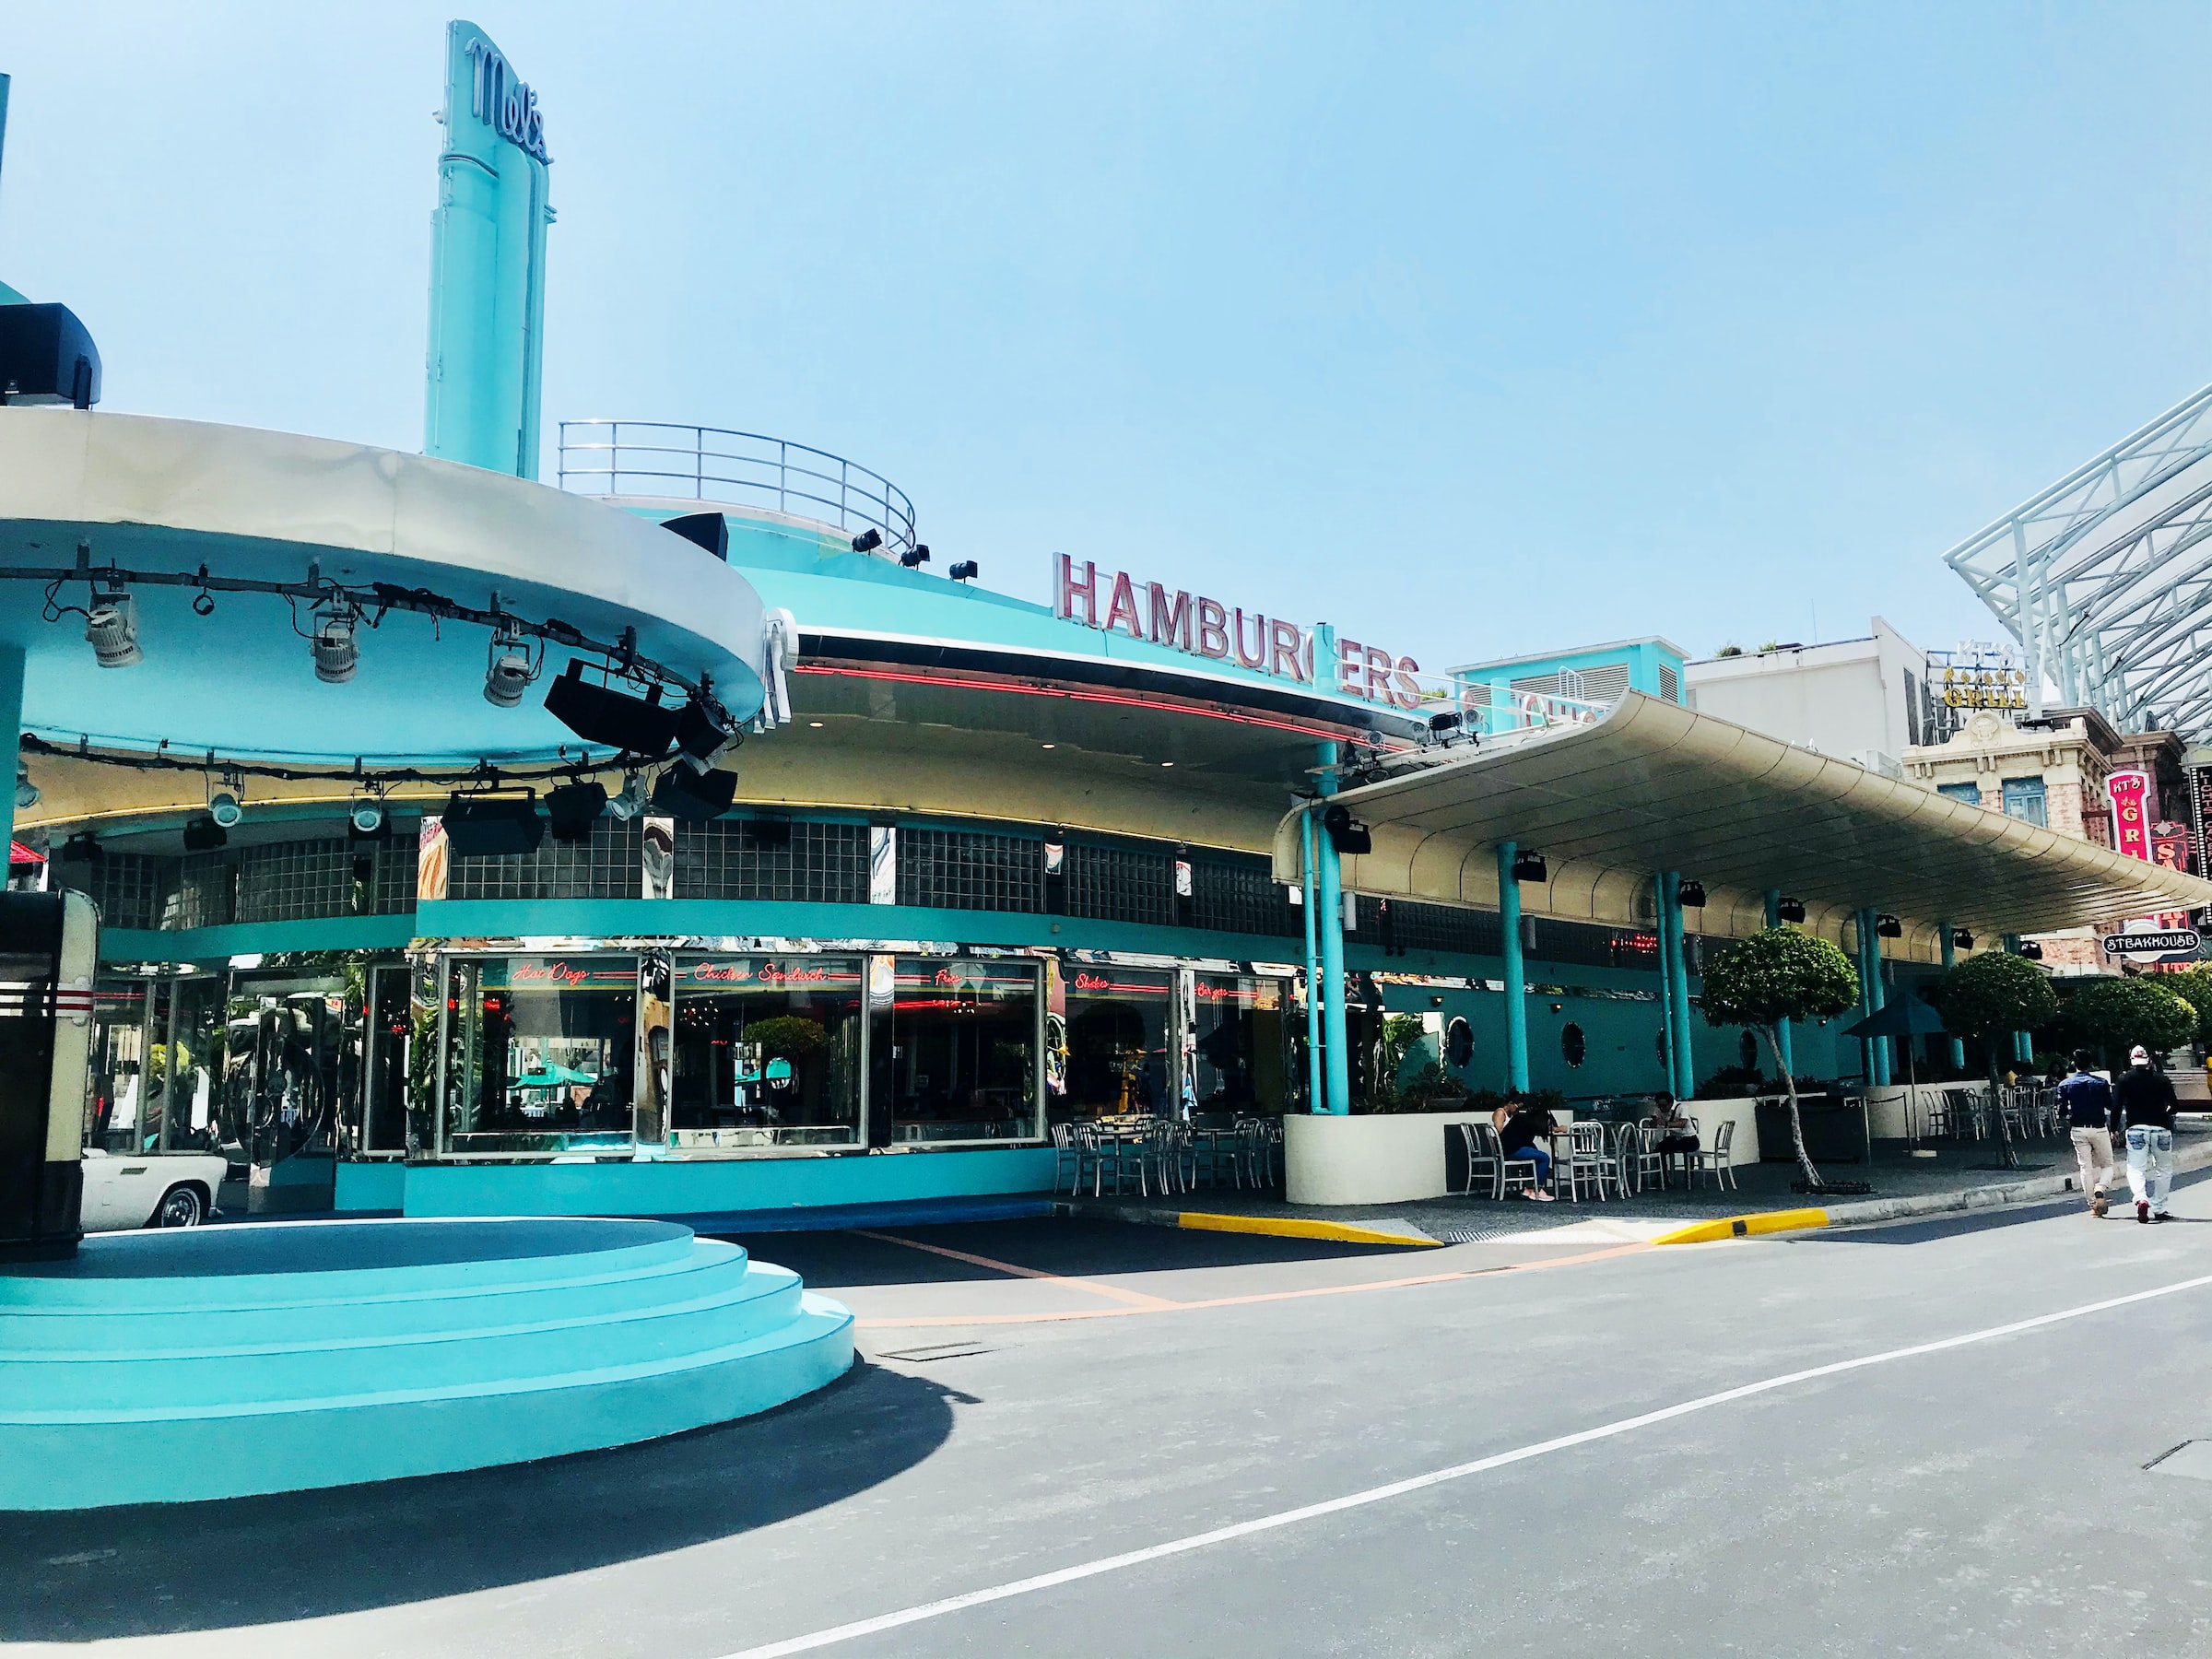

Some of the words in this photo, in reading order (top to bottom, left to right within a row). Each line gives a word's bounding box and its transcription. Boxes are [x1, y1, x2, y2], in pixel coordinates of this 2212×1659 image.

[465, 37, 555, 166] Mel's
[1943, 688, 2027, 708] GRILL
[2106, 935, 2195, 951] STEAKHOUSE
[512, 963, 546, 981] Hot
[547, 961, 590, 986] Dogs
[693, 961, 754, 982] Chicken
[758, 963, 828, 982] Sandwich
[935, 969, 963, 986] Fries
